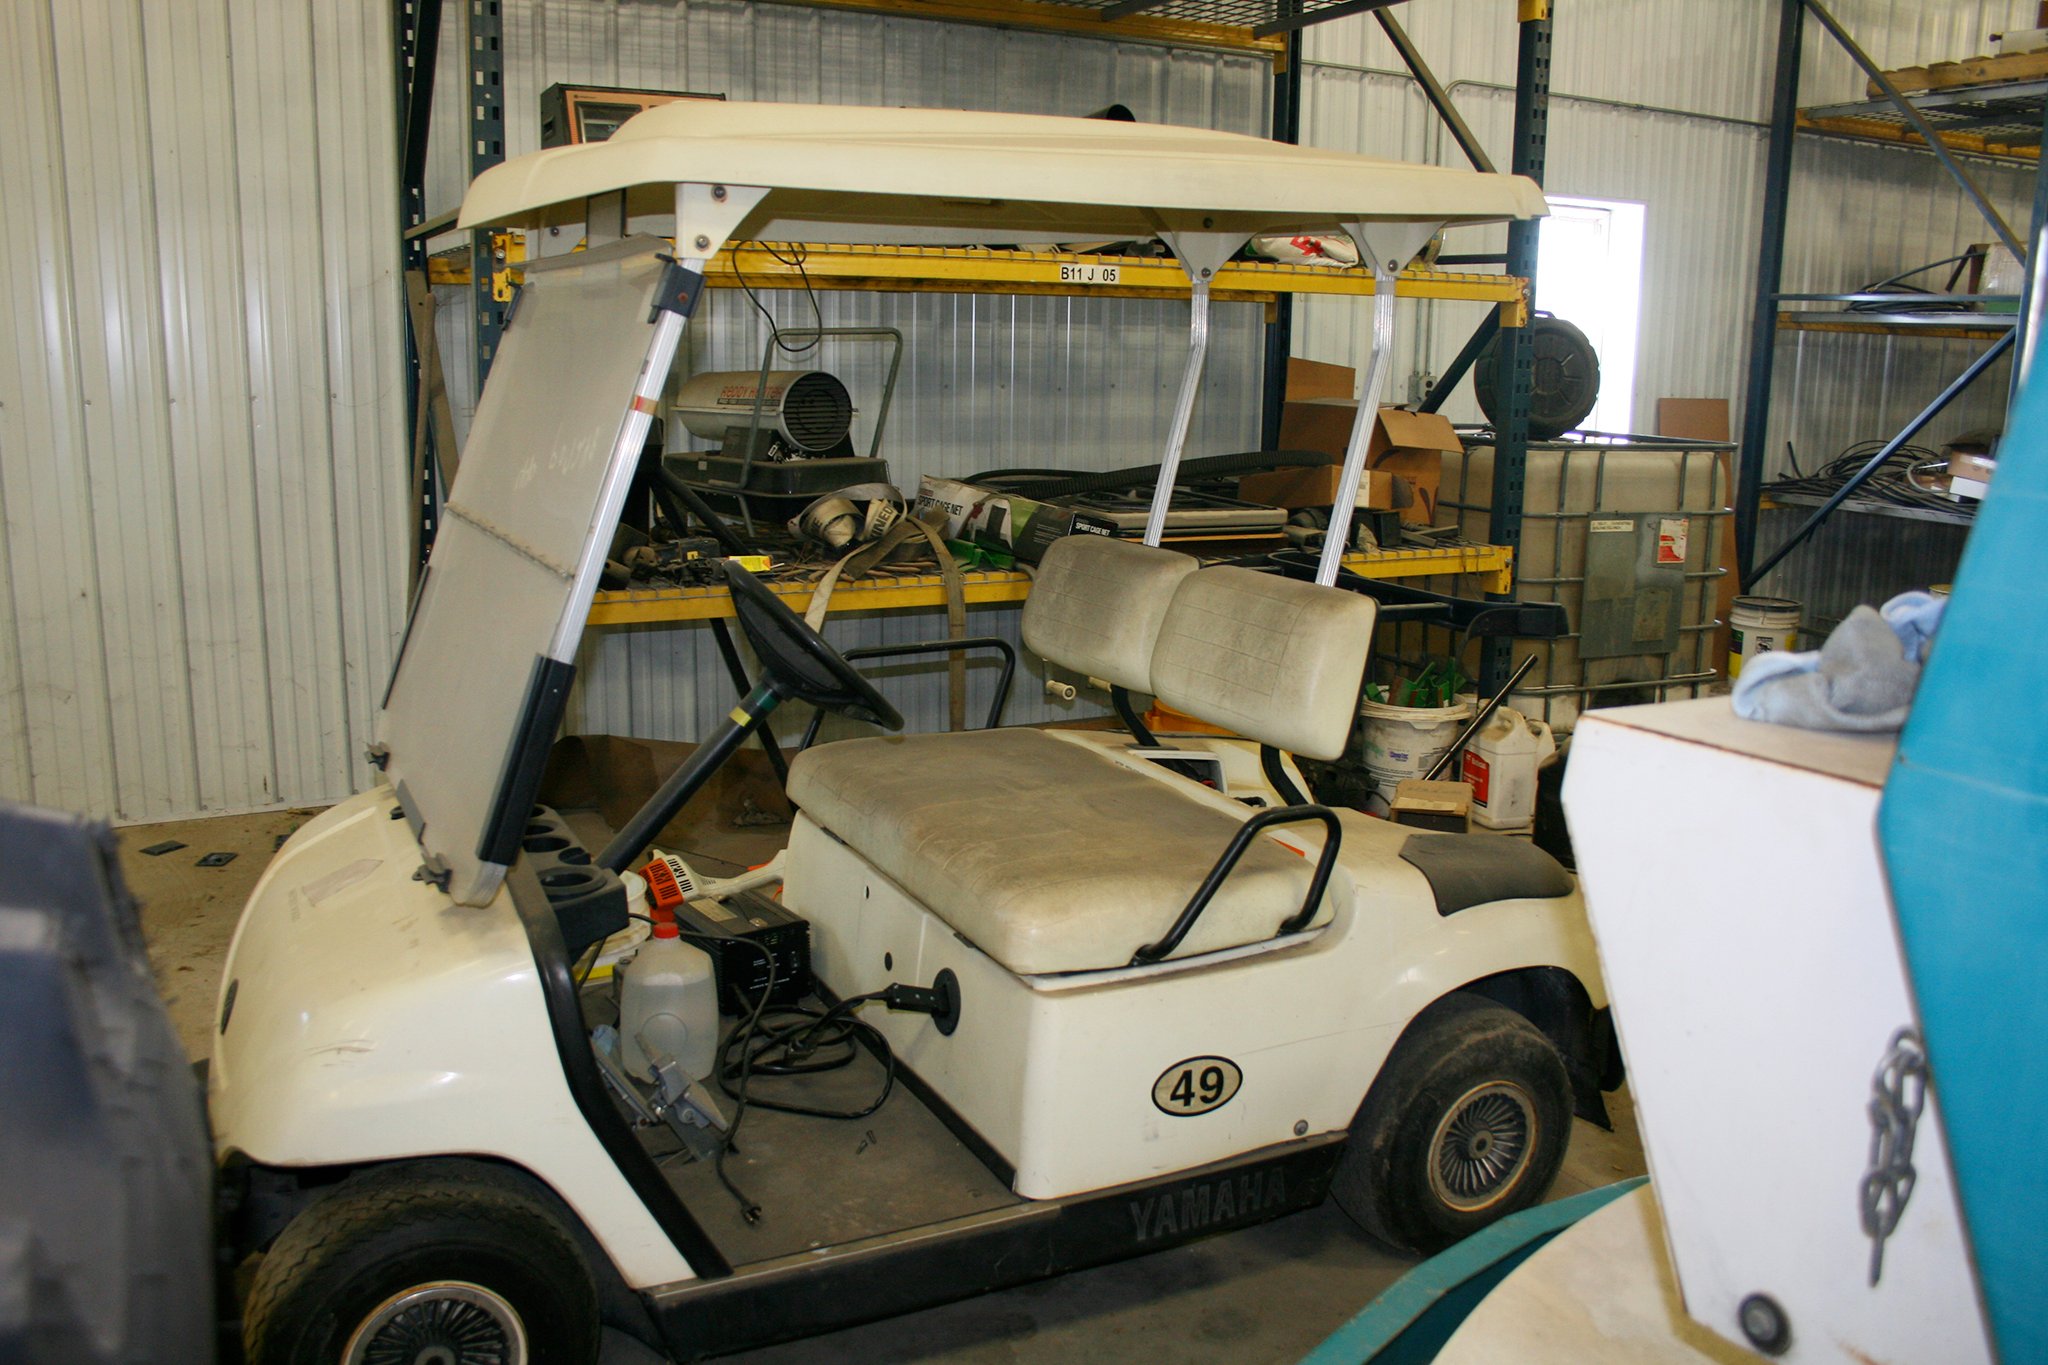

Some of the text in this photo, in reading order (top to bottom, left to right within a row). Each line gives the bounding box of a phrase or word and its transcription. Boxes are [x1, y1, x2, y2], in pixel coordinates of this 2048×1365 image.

[1061, 266, 1116, 282] B11 J 05
[918, 495, 936, 508] SPORT
[951, 503, 964, 517] NET
[1075, 522, 1111, 537] SPORT CAGE NET
[1169, 1065, 1224, 1107] 49
[1130, 1167, 1286, 1242] YAMAHA
